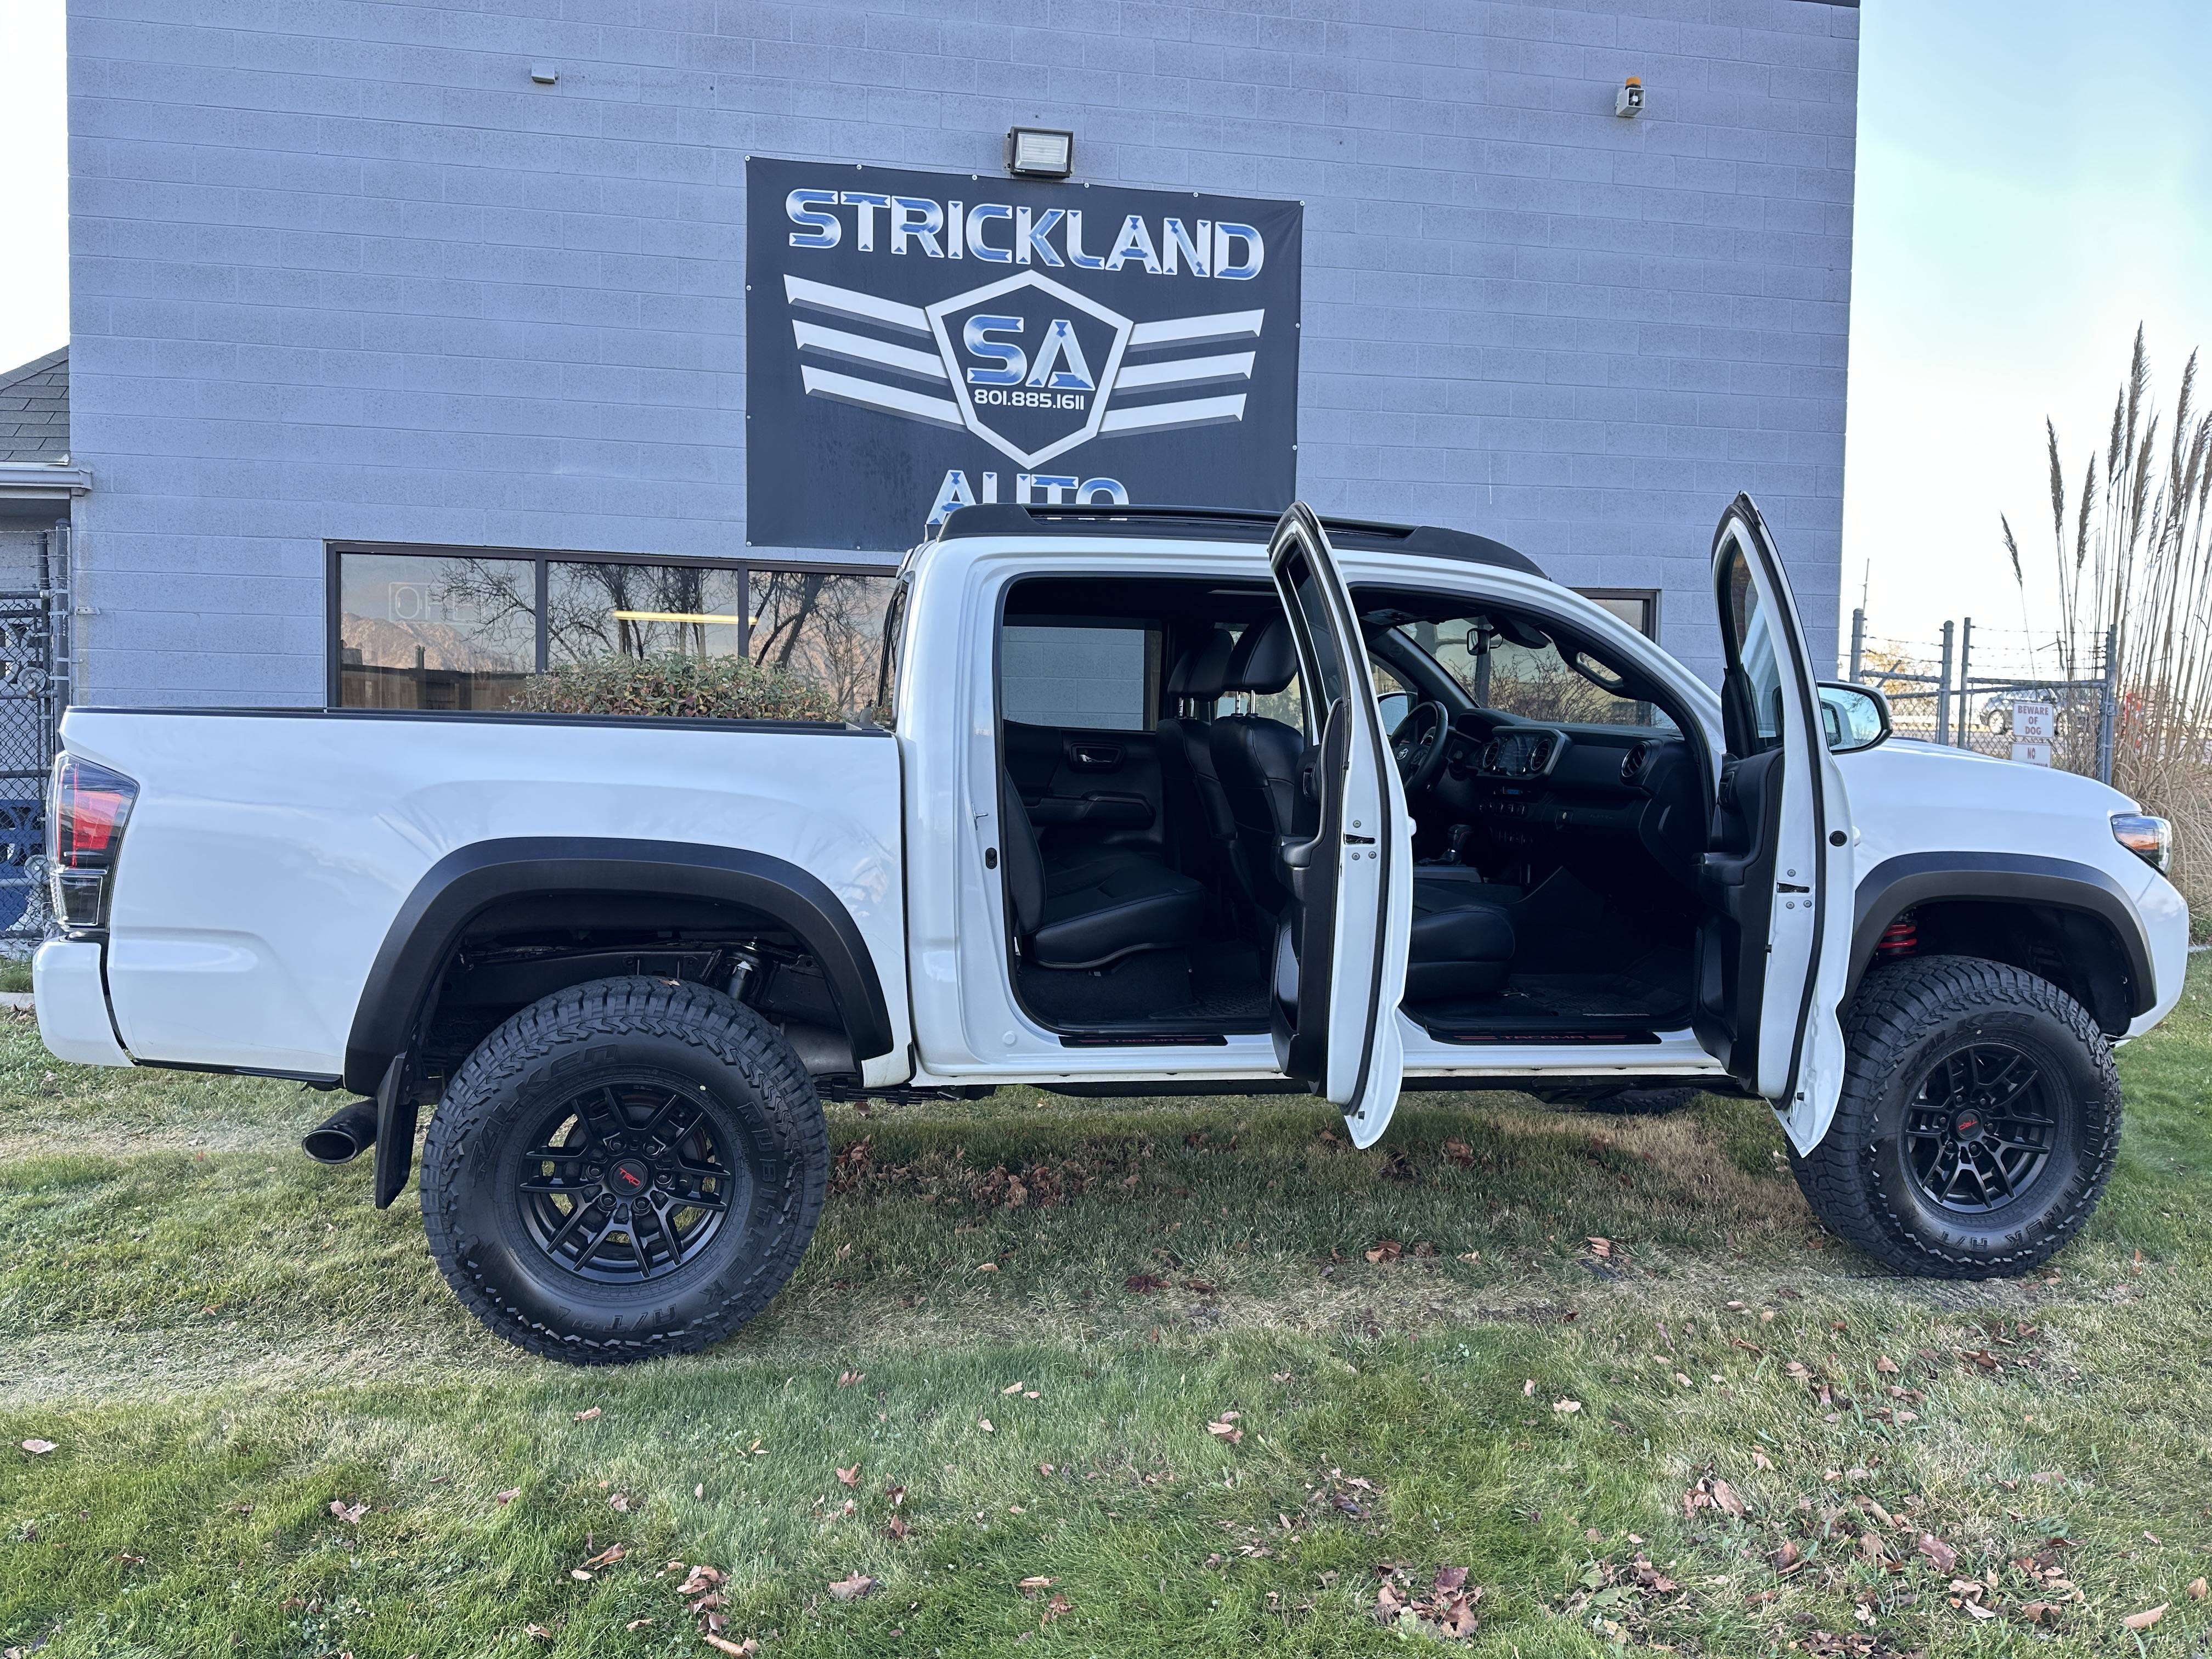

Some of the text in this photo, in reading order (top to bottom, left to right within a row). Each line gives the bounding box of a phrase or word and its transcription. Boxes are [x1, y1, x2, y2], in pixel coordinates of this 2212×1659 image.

[785, 188, 1265, 281] STRICKLAND
[963, 314, 1096, 391] SA
[974, 389, 1085, 410] 801.885.1611
[2018, 706, 2049, 715] BEWARE
[2028, 716, 2038, 725] OF
[2025, 726, 2041, 735] DOG
[2027, 747, 2036, 760] NO
[1959, 1119, 1978, 1130] TRD
[619, 1167, 641, 1186] TRD
